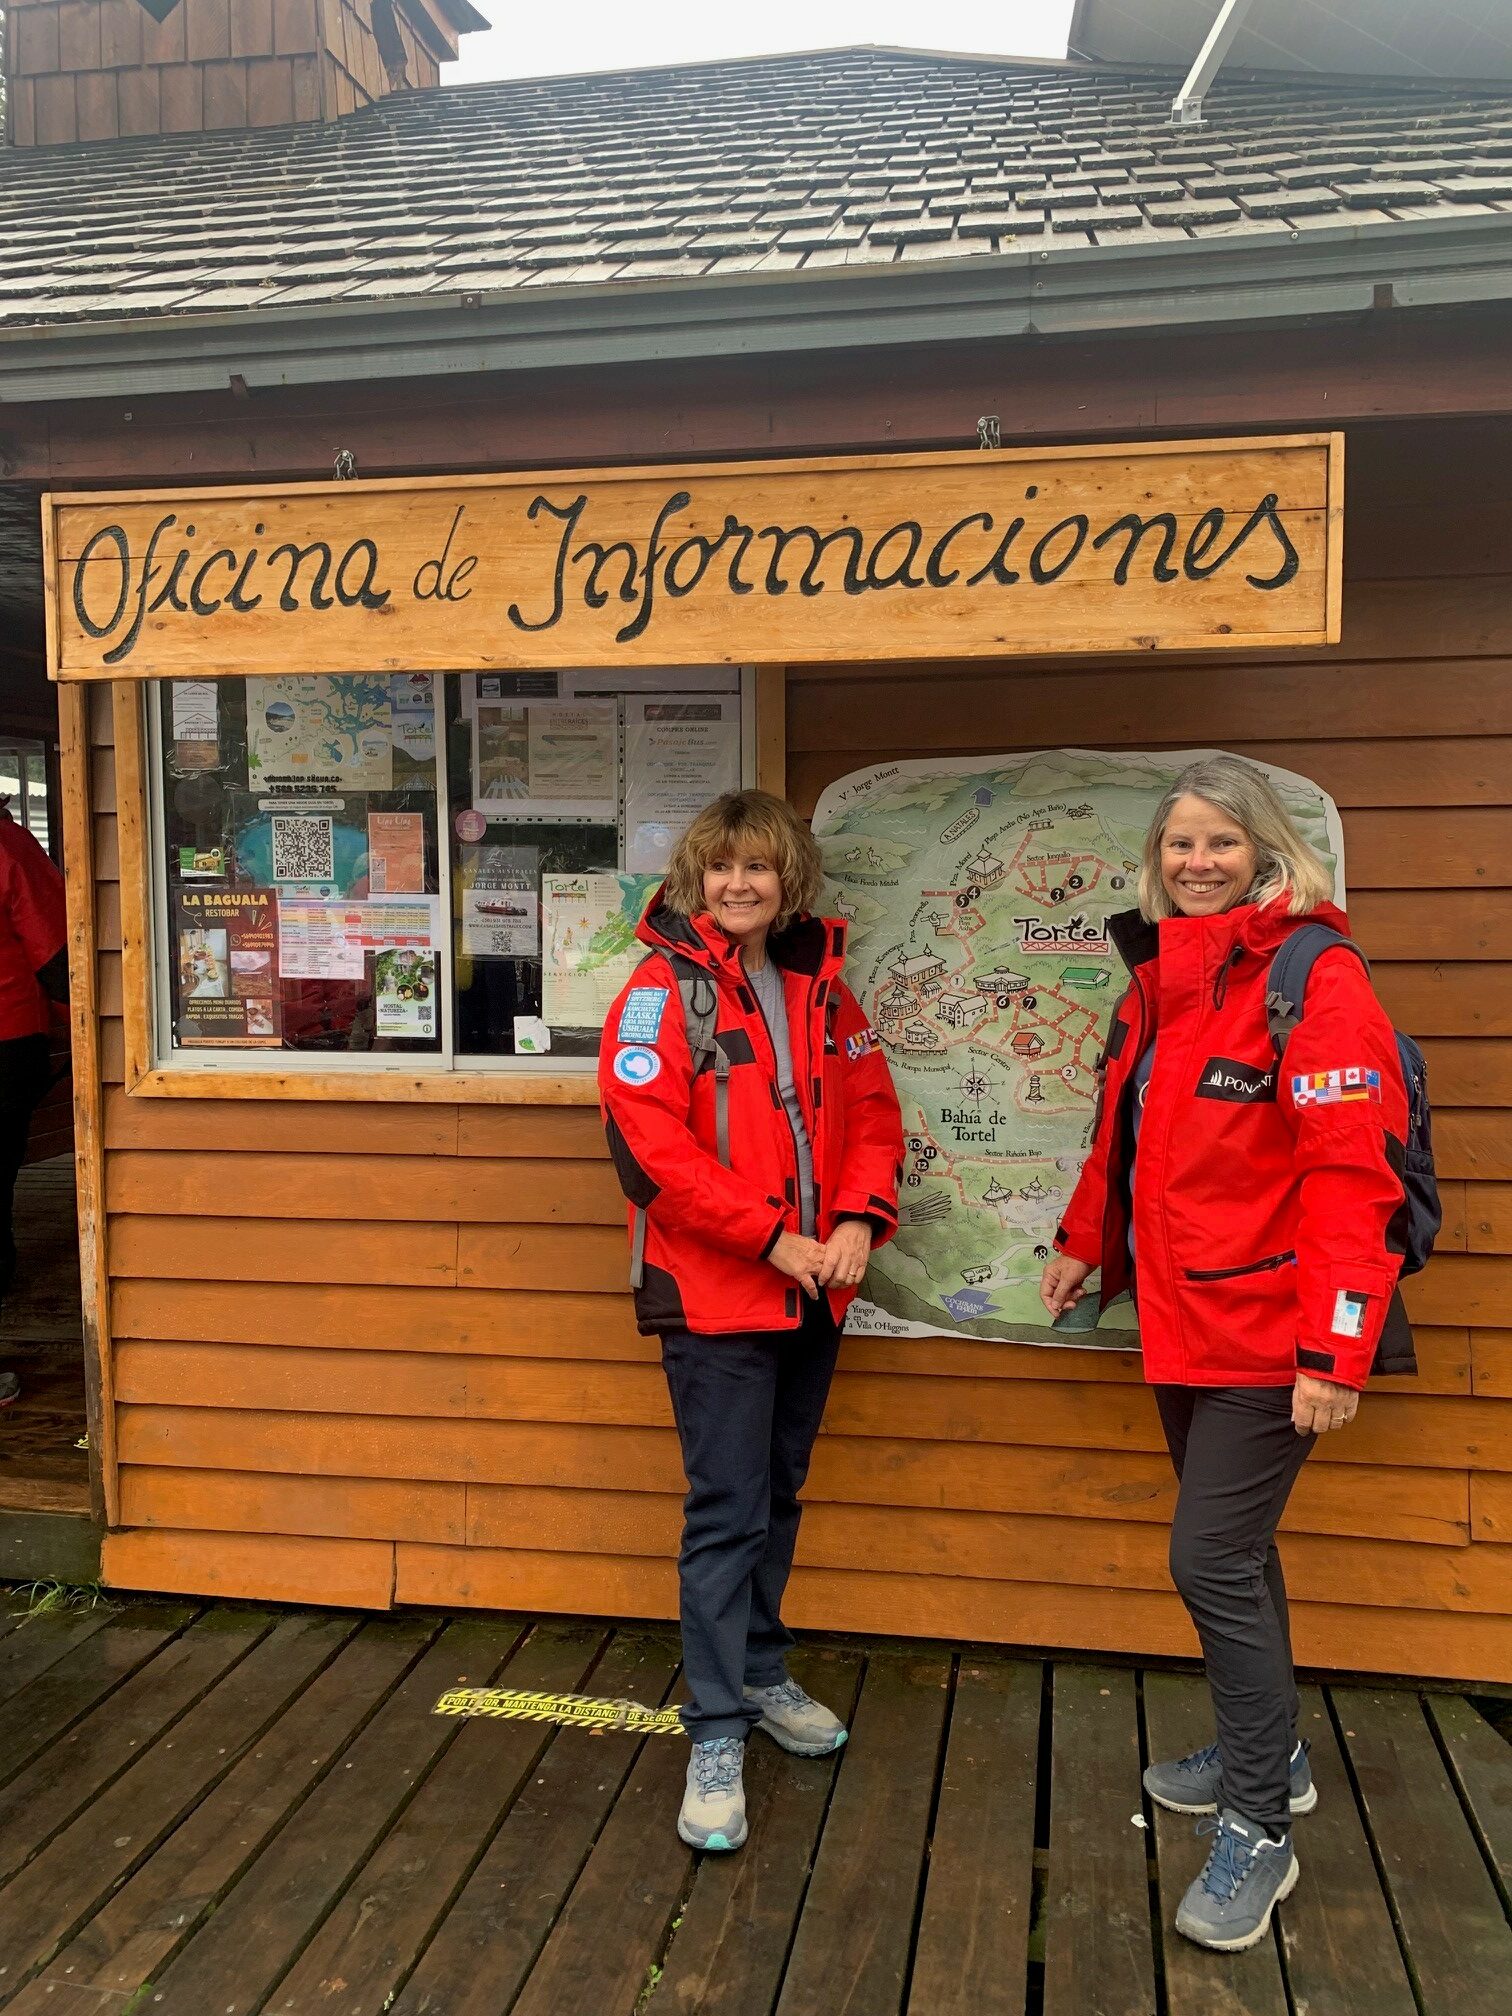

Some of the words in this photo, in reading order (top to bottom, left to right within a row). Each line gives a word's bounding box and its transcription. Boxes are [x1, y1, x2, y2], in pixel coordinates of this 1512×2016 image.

[73, 513, 391, 664] Oficina
[412, 504, 480, 602] de
[507, 486, 1300, 644] Informaciones
[852, 779, 873, 794] Jorge
[873, 767, 900, 782] Montt
[949, 811, 977, 839] NATALES
[1026, 854, 1045, 862] Sector
[470, 882, 497, 890] JORGE
[500, 882, 531, 890] MONTT
[544, 879, 589, 892] Tortel
[1072, 878, 1080, 888] 2
[969, 886, 980, 899] 4
[1054, 889, 1061, 901] 3
[182, 894, 200, 906] LA
[203, 894, 269, 906] BAGUALA
[958, 895, 969, 908] 5
[205, 908, 240, 917] RESTOBAR
[1013, 917, 1108, 942] Tortel
[998, 995, 1007, 1008] 6
[1025, 996, 1034, 1009] 7
[624, 1011, 657, 1020] ALASKA
[622, 1024, 655, 1033] USHUAIA
[1065, 1069, 1073, 1077] 2
[940, 1108, 981, 1124] Bahía
[988, 1110, 1007, 1125] de
[951, 1126, 996, 1142] Tortel
[909, 1141, 922, 1150] 10
[926, 1148, 936, 1158] 11
[917, 1161, 928, 1170] 12
[909, 1175, 920, 1188] 13
[1034, 1248, 1047, 1261] 18
[851, 1304, 876, 1318] Yungay
[856, 1320, 872, 1330] Villa
[446, 1697, 468, 1706] POR
[502, 1699, 559, 1712] MANTENGA
[558, 1704, 572, 1713] LA
[626, 1712, 642, 1721] DE
